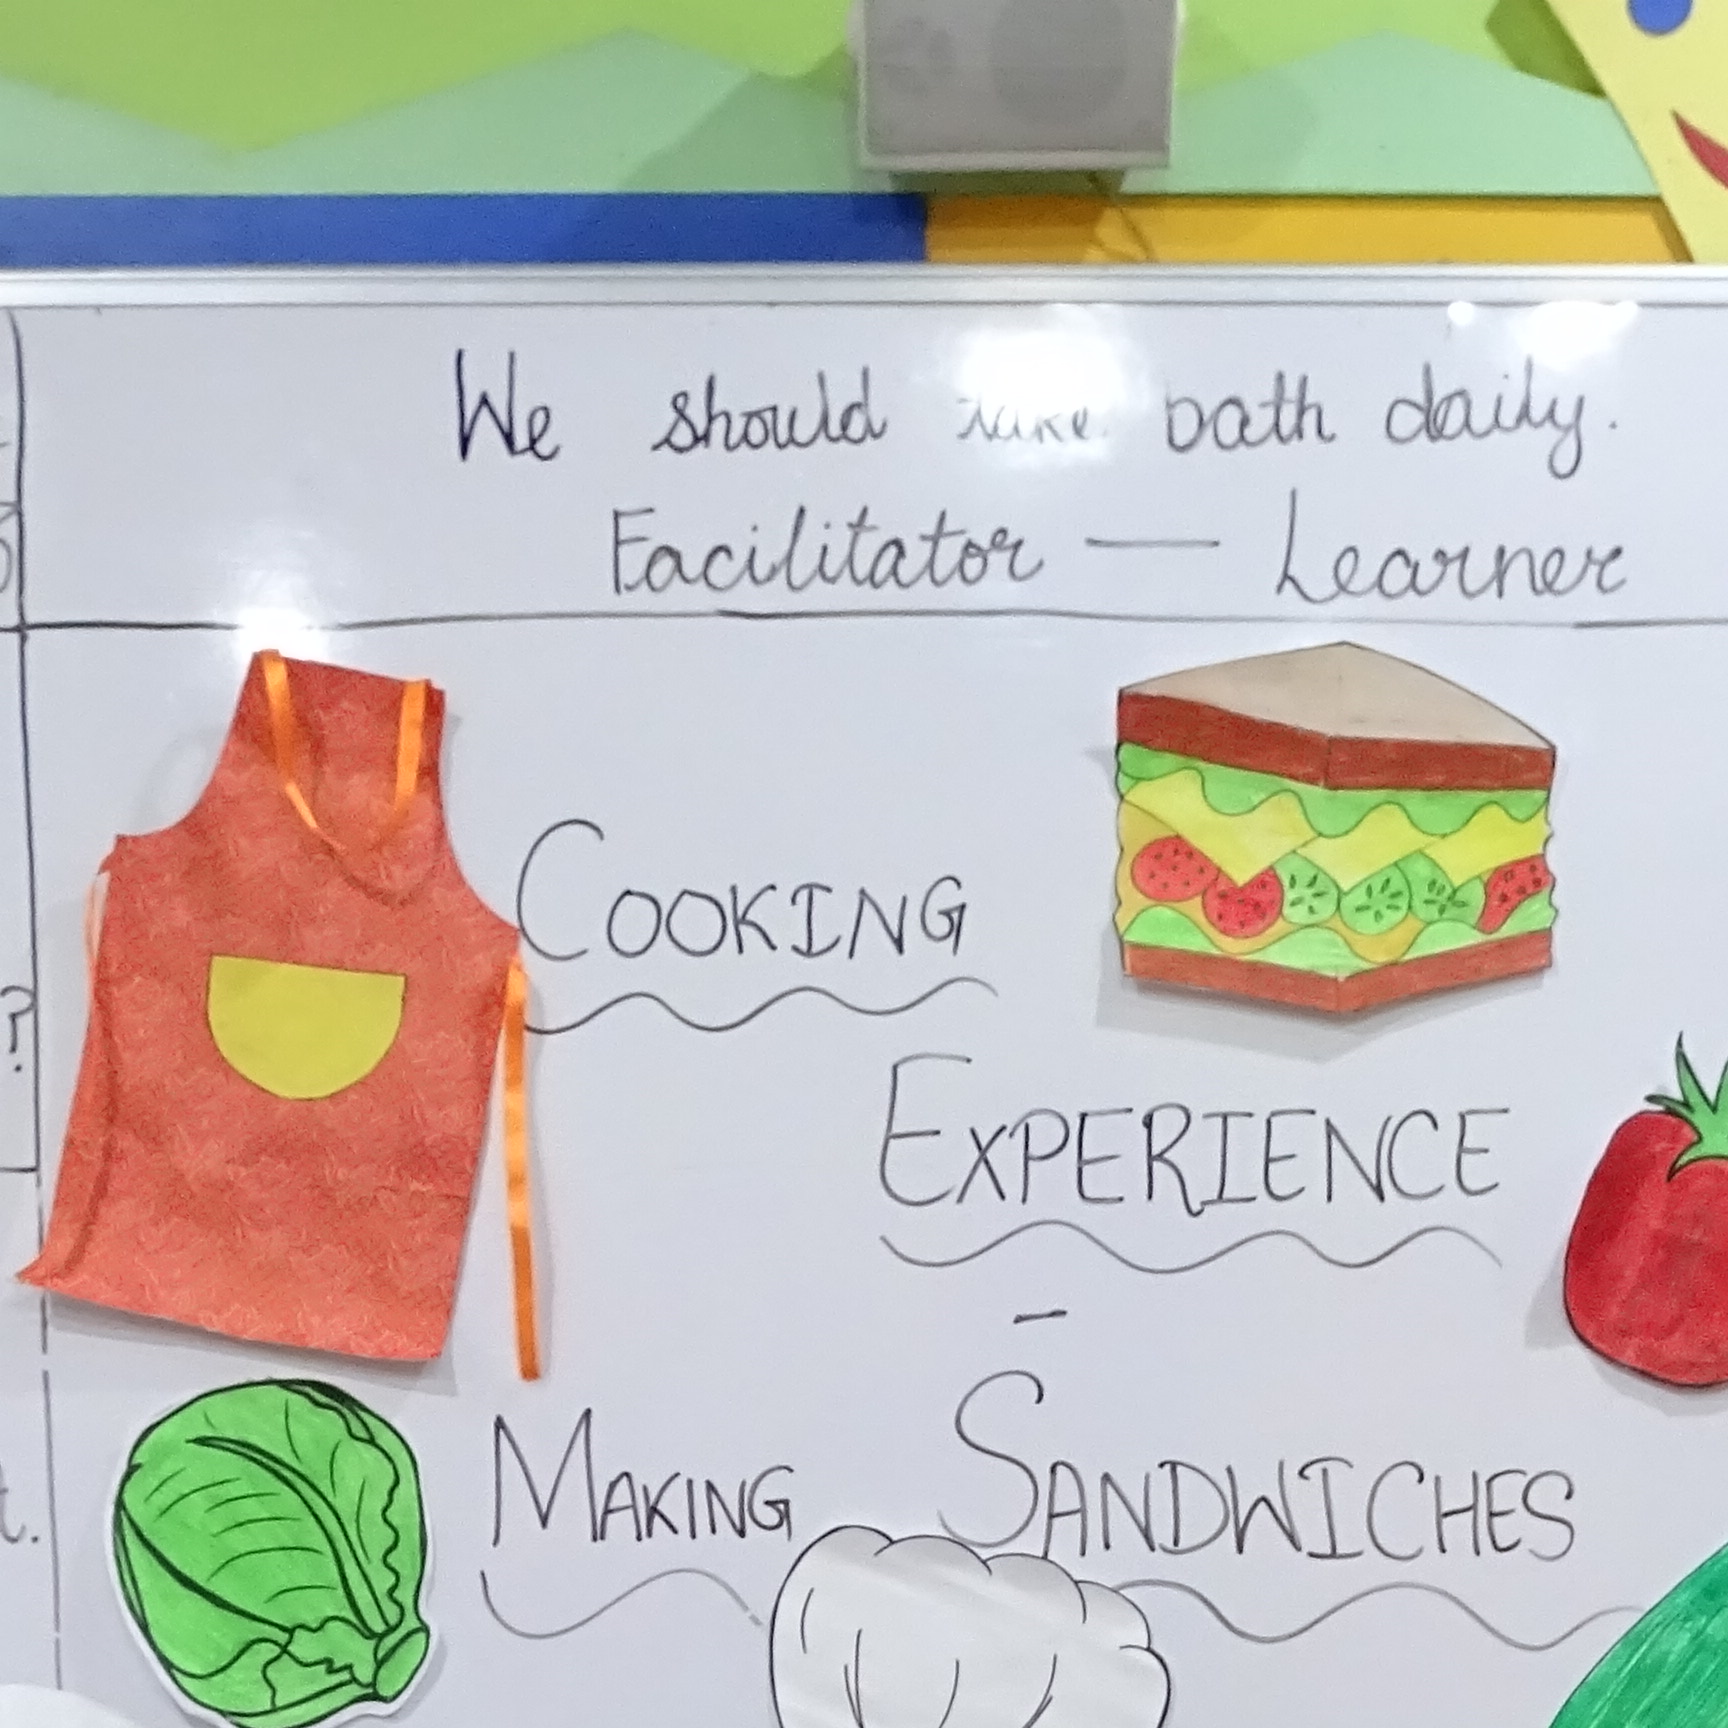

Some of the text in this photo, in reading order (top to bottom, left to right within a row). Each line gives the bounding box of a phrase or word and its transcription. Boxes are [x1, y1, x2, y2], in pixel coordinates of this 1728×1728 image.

[455, 347, 562, 463] We
[651, 365, 888, 454] should
[1165, 370, 1336, 454] bath
[613, 504, 1045, 596] Facilitator
[1275, 488, 1628, 603] Learner
